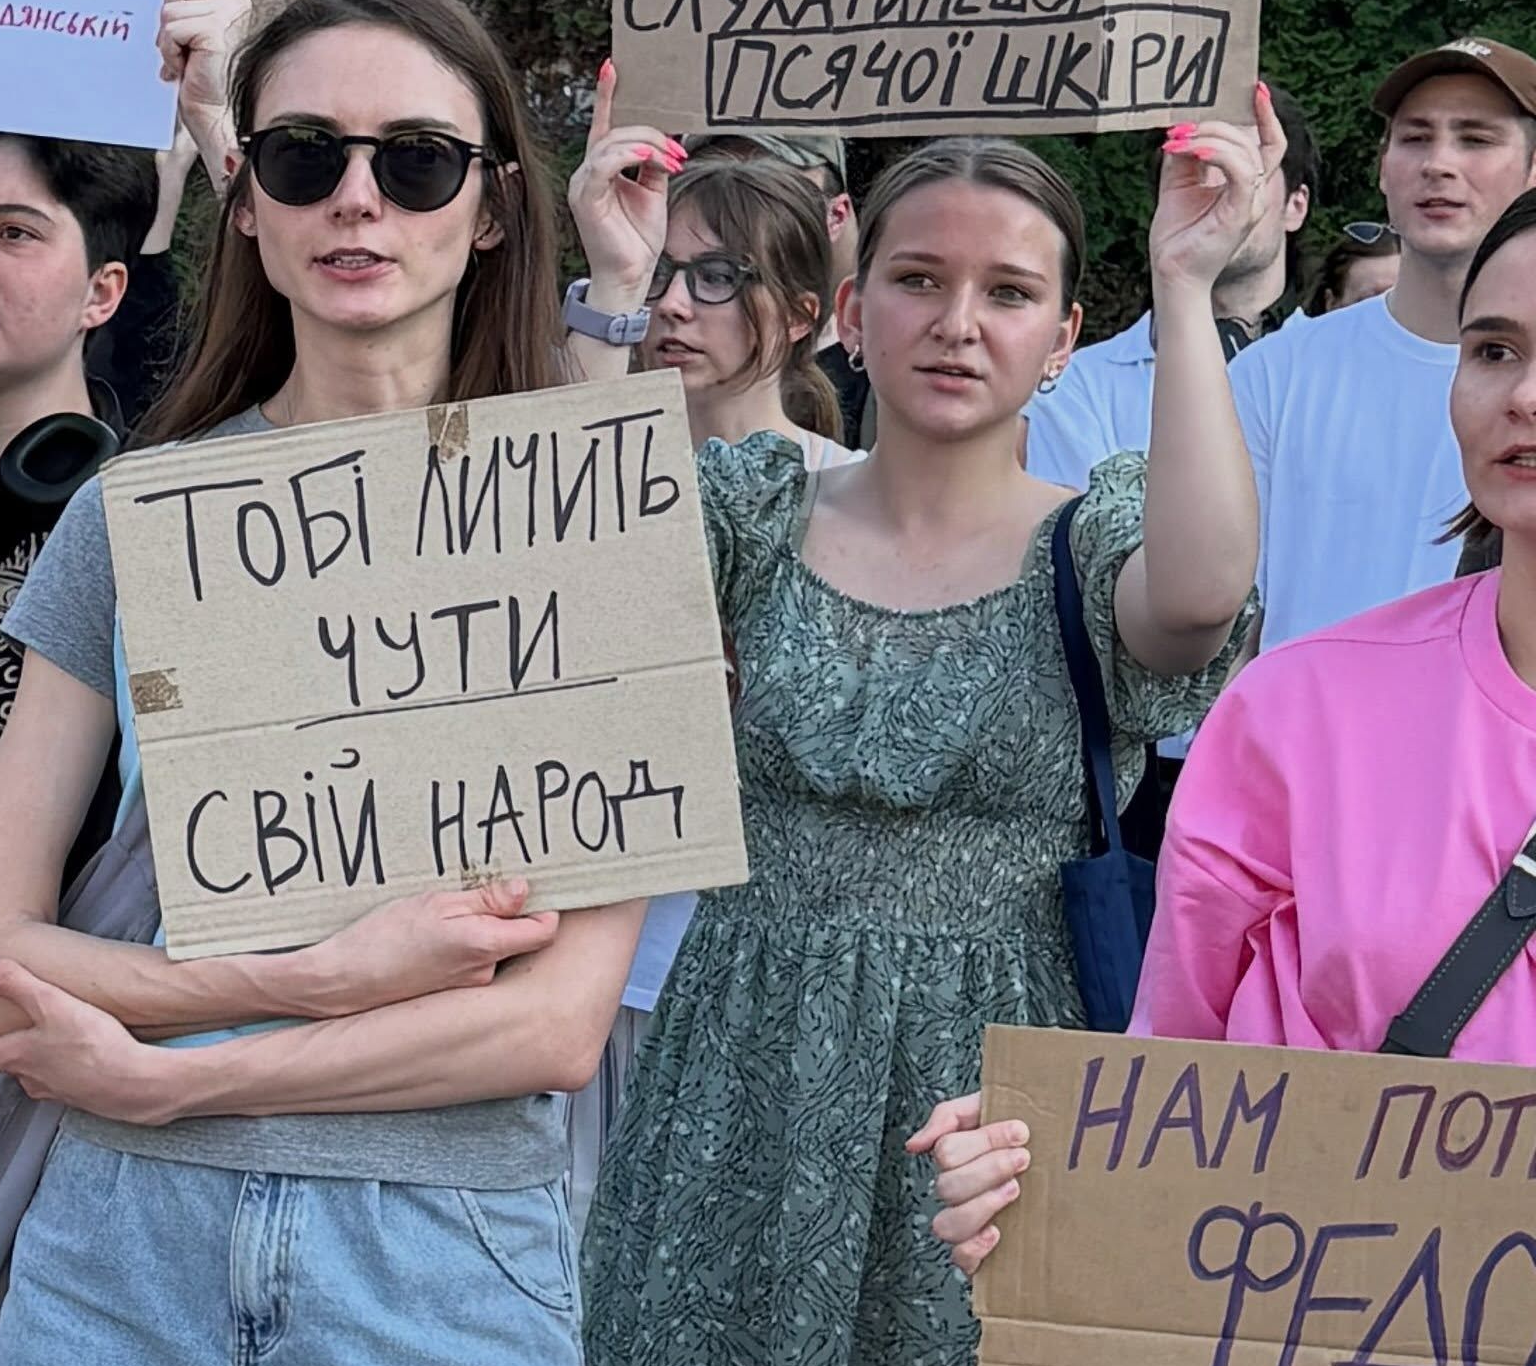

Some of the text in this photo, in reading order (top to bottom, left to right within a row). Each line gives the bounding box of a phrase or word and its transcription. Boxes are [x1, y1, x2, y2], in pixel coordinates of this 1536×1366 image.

[717, 16, 1216, 119] ПСЯЧОЇ ШКІРИ
[134, 408, 681, 601] ТОБІ ЛИЧИТЬ
[317, 591, 561, 707] ЧУТИ
[185, 747, 684, 896] СВІЙ НАРОД
[1068, 1055, 1536, 1180] НАМ ПОТ
